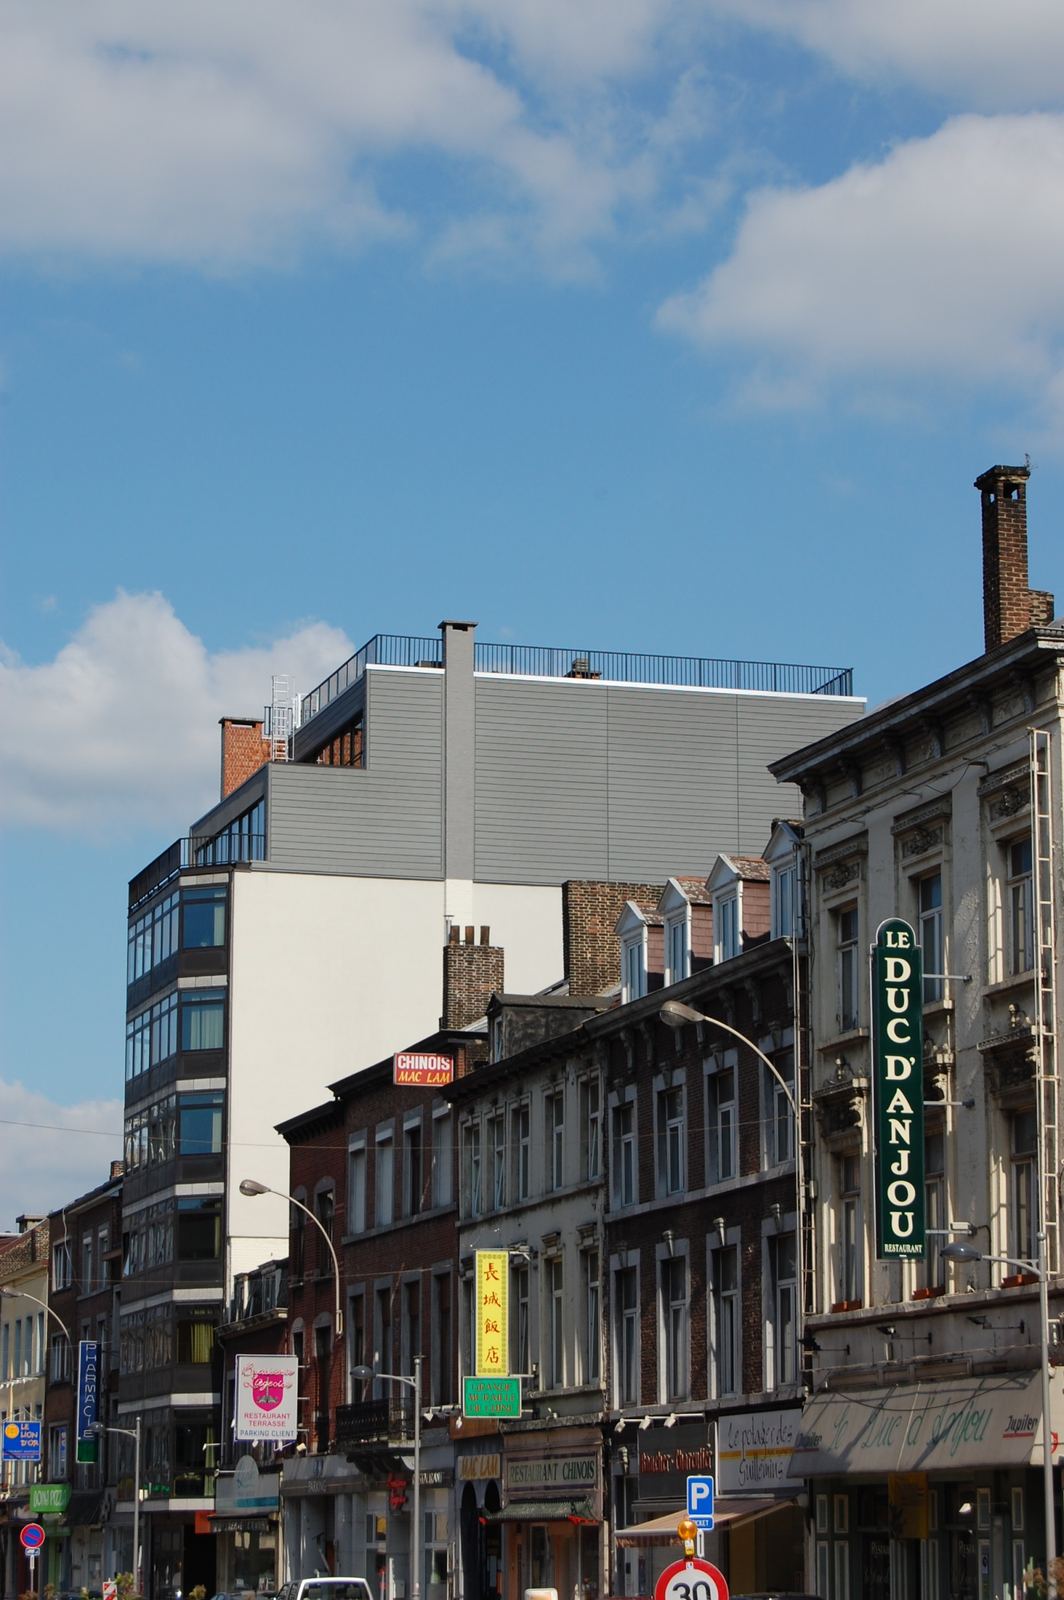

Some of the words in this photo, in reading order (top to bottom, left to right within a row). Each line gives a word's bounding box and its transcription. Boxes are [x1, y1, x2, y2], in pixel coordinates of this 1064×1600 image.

[886, 931, 910, 948] LE
[884, 957, 911, 1043] DUC
[397, 1055, 450, 1070] CHINOIS
[398, 1071, 422, 1082] MAC
[426, 1072, 450, 1083] LAM
[884, 1244, 922, 1253] RESTAURANT
[483, 1262, 502, 1364] 長城飯店
[83, 1343, 97, 1438] PHARMACIE
[1004, 1413, 1039, 1433] Jupiler
[21, 1431, 38, 1439] LION
[510, 1463, 558, 1482] RESTAURANT
[562, 1460, 594, 1480] CHINOIS
[691, 1482, 709, 1510] P
[672, 1581, 711, 1600] 30
